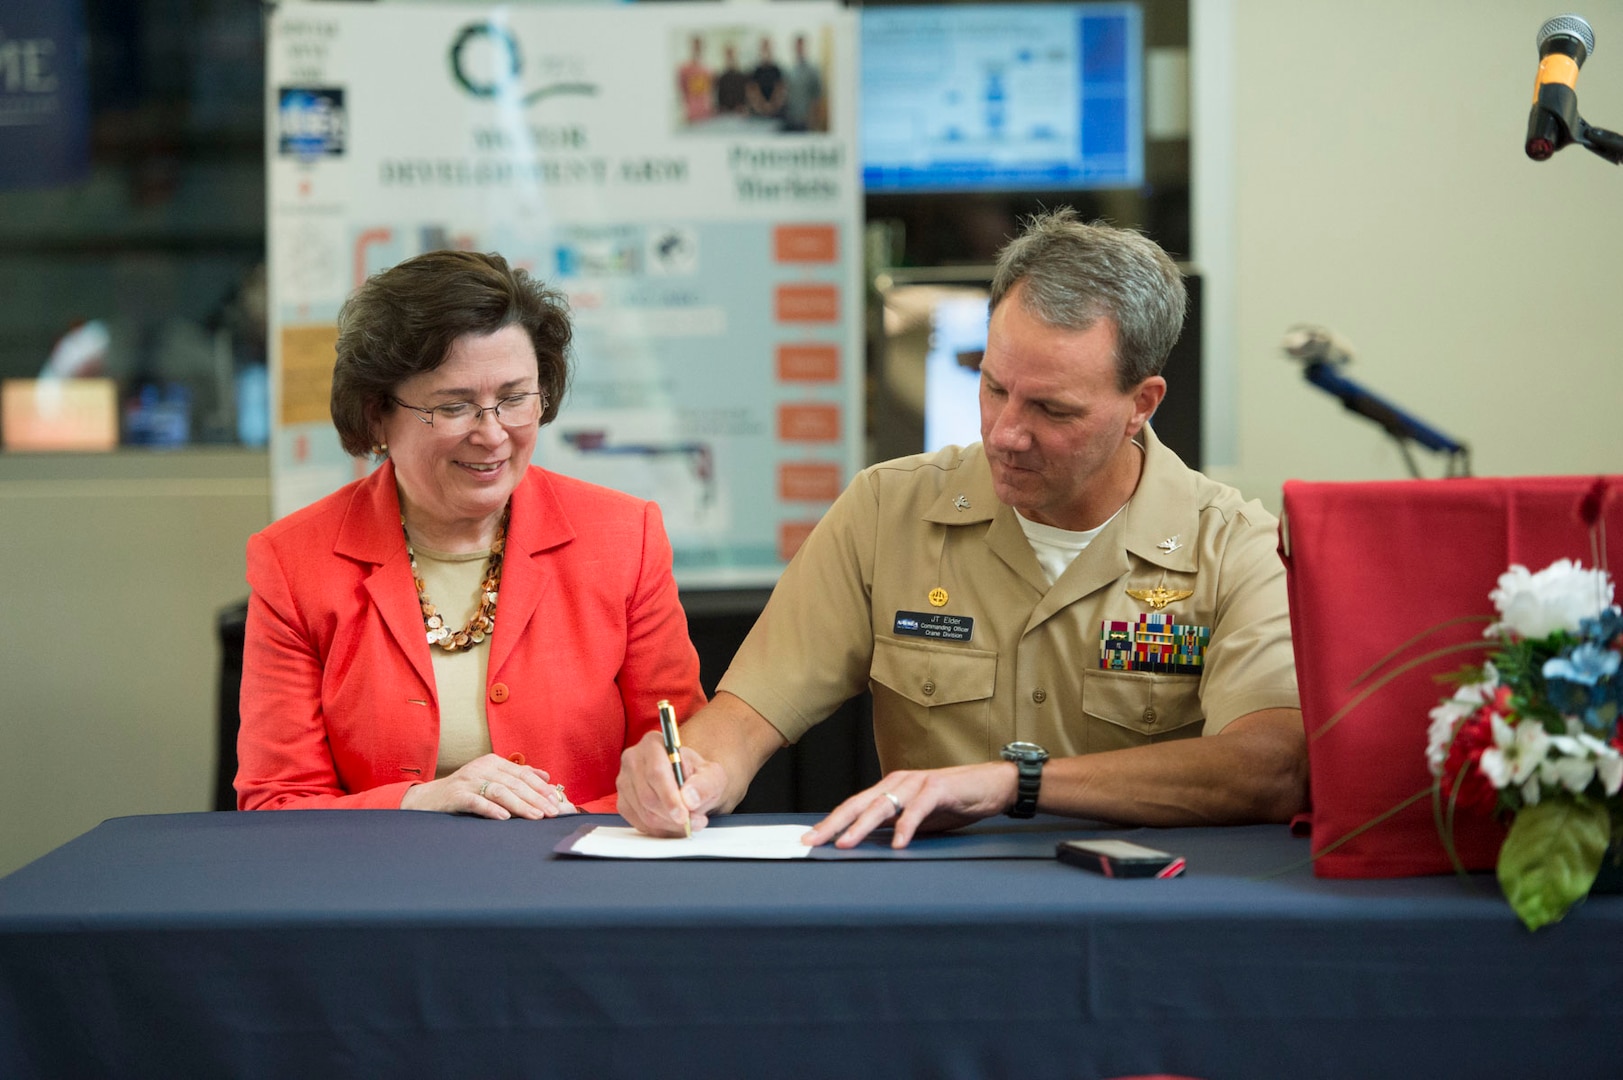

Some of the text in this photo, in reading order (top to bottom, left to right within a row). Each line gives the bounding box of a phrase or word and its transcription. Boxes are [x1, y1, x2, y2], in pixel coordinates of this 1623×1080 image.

[472, 125, 588, 149] MOOR
[379, 157, 607, 185] DEVELOPENT
[920, 622, 951, 632] Commanding
[953, 625, 969, 633] Officer
[944, 616, 961, 624] Elder
